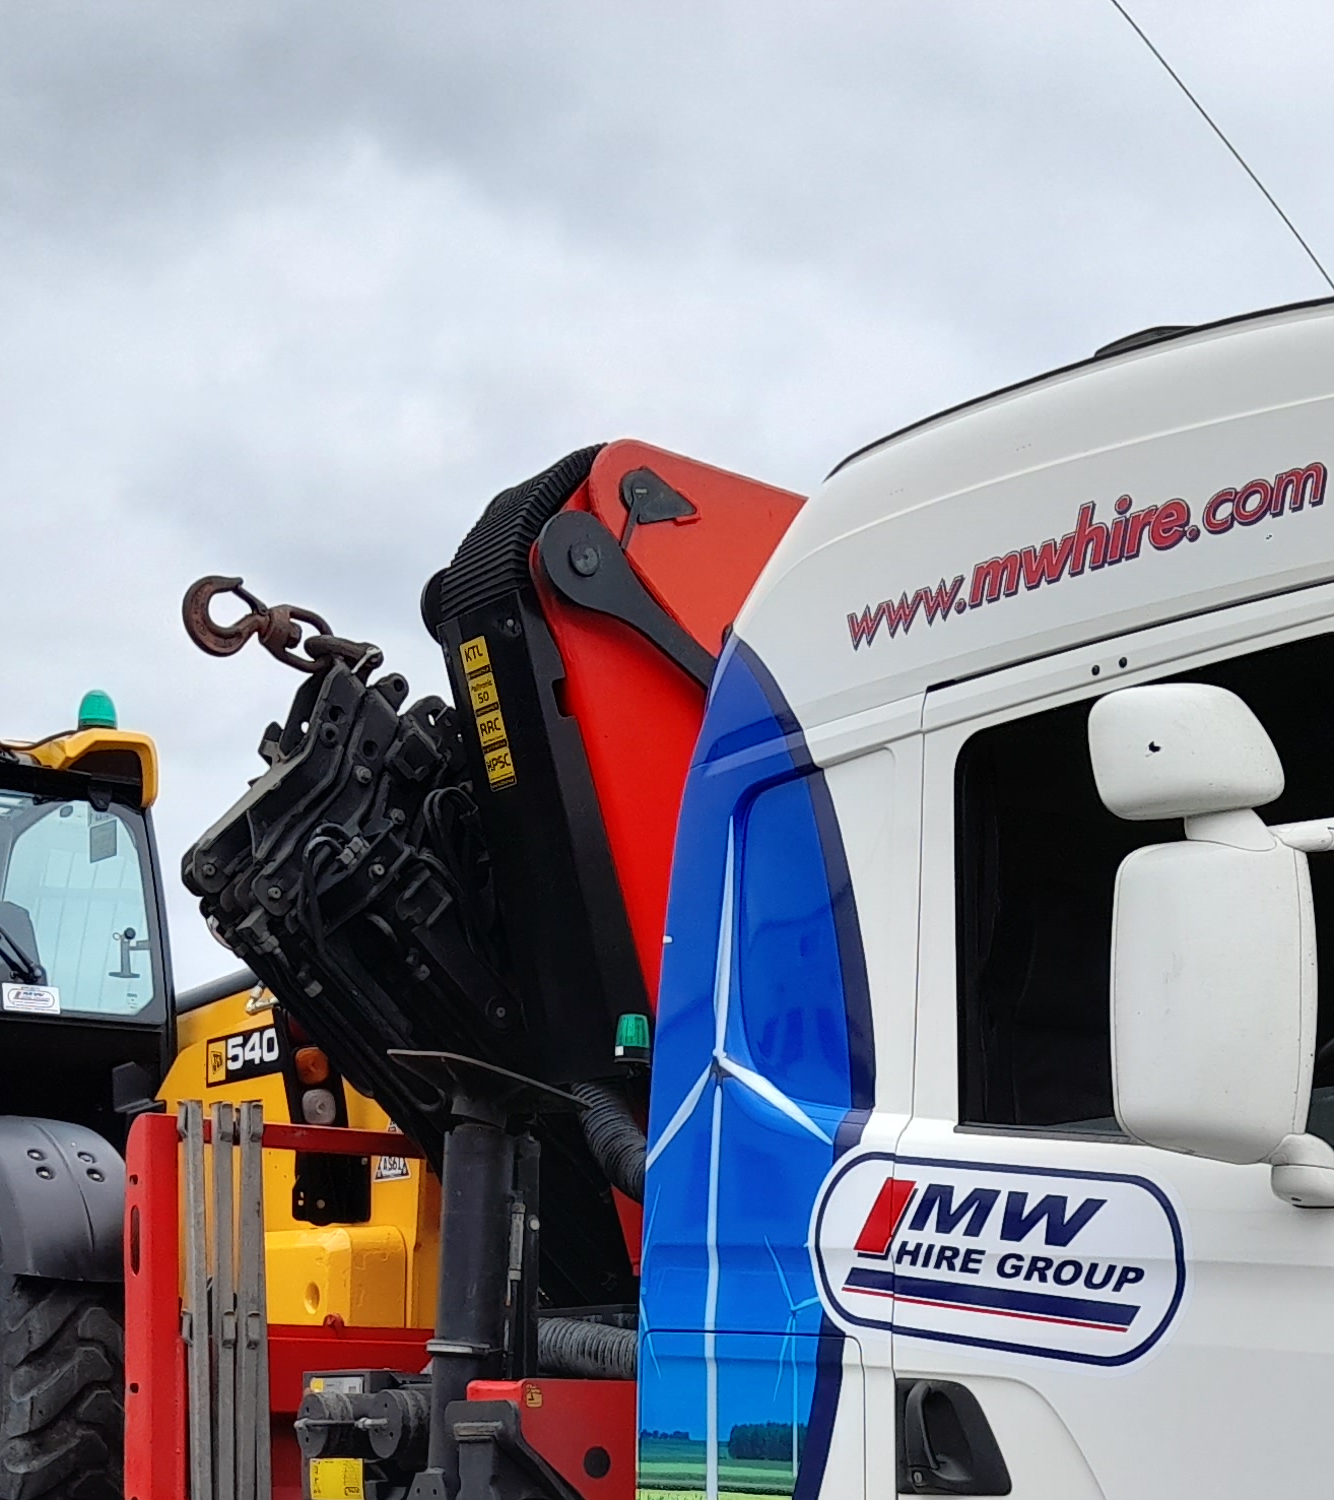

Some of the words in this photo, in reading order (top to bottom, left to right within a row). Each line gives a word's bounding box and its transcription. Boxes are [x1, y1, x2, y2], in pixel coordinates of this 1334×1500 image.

[847, 461, 1328, 650] www.mwhire.com
[477, 691, 490, 704] 50
[480, 717, 502, 737] RRC
[227, 1027, 279, 1071] 540
[908, 1183, 1108, 1248] MW
[895, 1240, 986, 1275] HIRE
[996, 1252, 1145, 1293] GROUP
